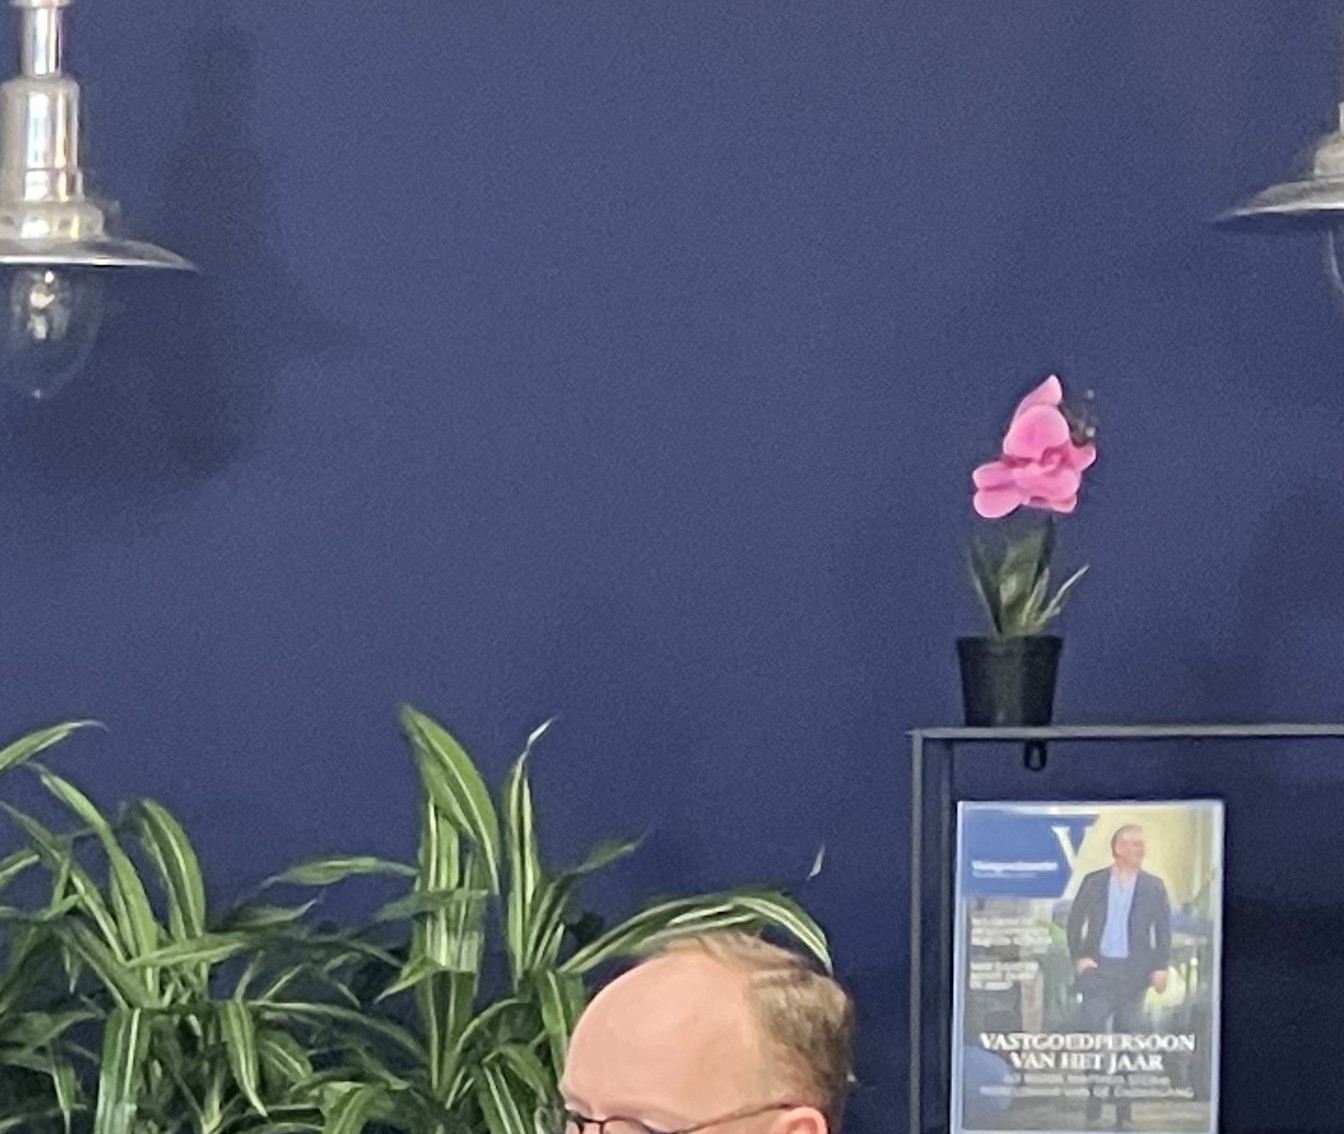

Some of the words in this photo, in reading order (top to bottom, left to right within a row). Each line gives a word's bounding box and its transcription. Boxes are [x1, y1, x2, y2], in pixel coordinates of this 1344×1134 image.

[979, 1033, 1196, 1051] VASTGOEDPERSOON
[1010, 1051, 1055, 1070] VAN
[1061, 1052, 1105, 1069] HET
[1108, 1053, 1164, 1074] JAAR
